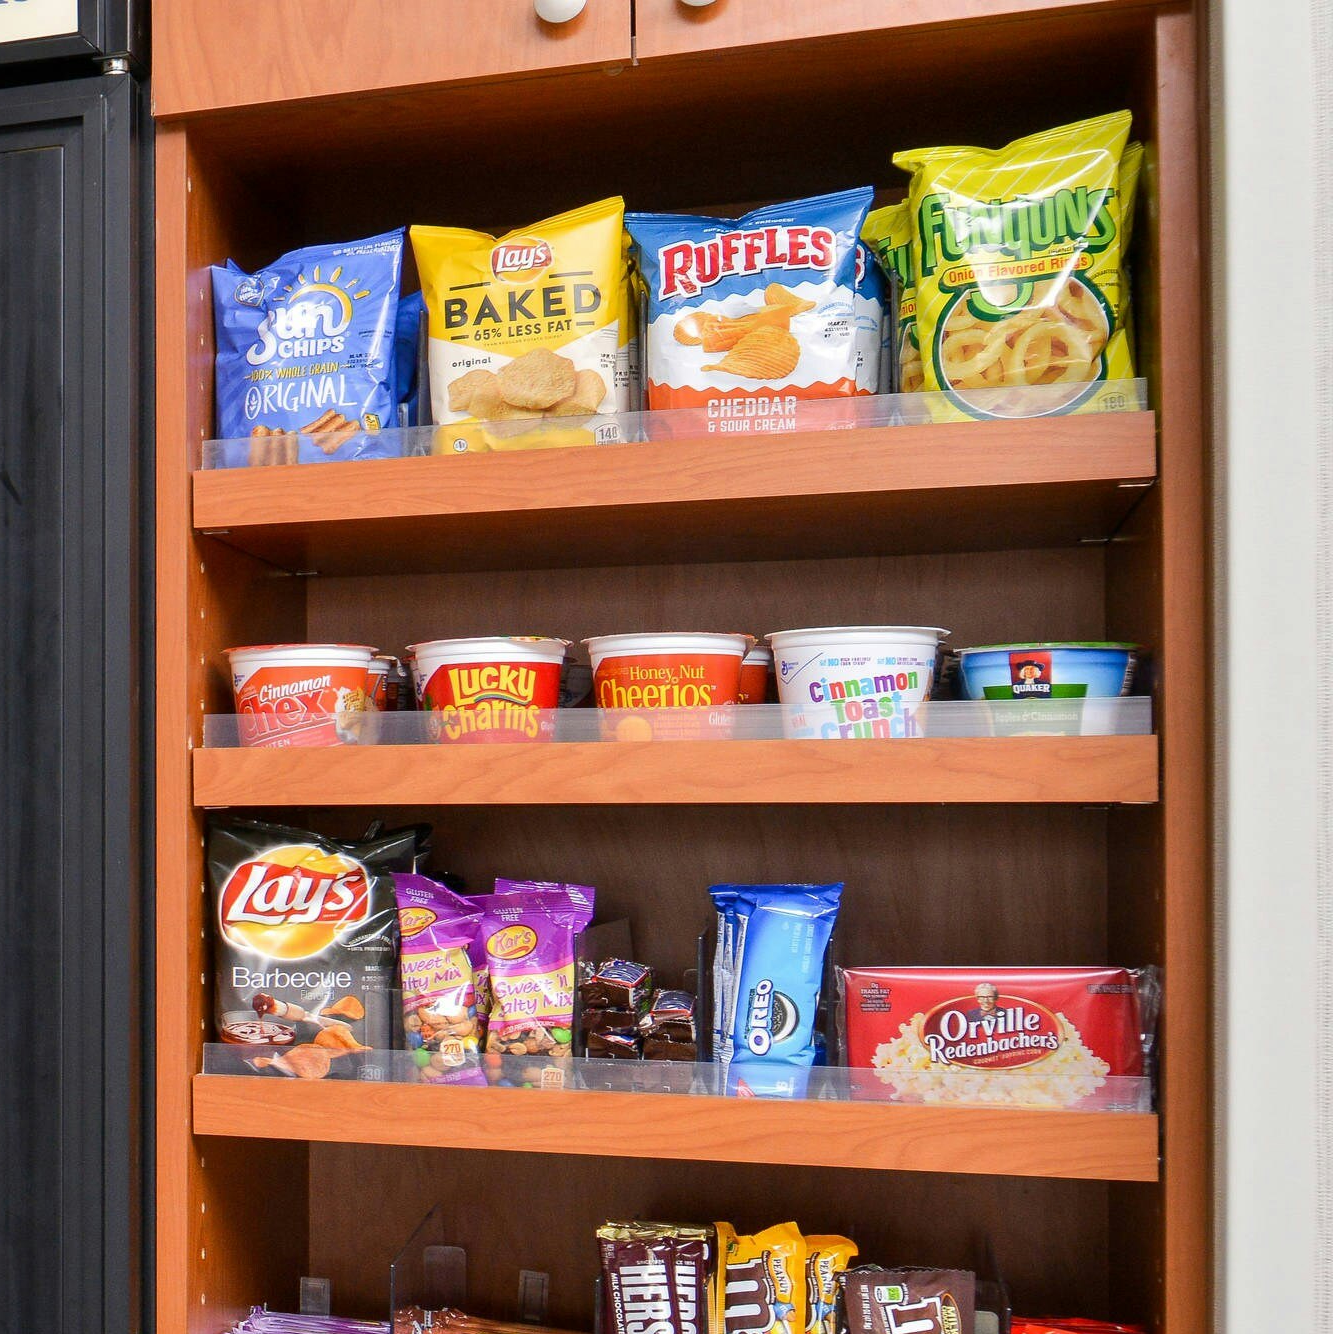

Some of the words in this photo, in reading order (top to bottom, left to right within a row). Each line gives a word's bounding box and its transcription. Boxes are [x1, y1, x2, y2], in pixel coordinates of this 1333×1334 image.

[496, 244, 548, 273] Lay's
[661, 226, 834, 296] RUFFLES
[988, 259, 1045, 278] Flavored
[444, 283, 602, 329] BAKED
[246, 300, 352, 365] Sun
[474, 328, 502, 341] 65%
[508, 323, 541, 337] LESS
[547, 319, 572, 332] FAT
[277, 336, 346, 359] CHIPS
[276, 365, 308, 379] WHOLE
[309, 362, 340, 375] GRAIN
[452, 357, 492, 368] original
[245, 374, 357, 420] ORIGINAL
[707, 396, 797, 418] CHEDDAR
[708, 422, 716, 433] &
[720, 420, 750, 432] SOUR
[754, 419, 796, 432] CREAM
[448, 664, 536, 707] Lucky
[630, 666, 674, 684] Honey
[680, 665, 705, 679] Nut
[809, 671, 918, 703] Cinnamon
[259, 674, 330, 702] Cinnamon
[599, 676, 712, 714] Cheerios
[1013, 683, 1050, 694] QUAKER
[239, 689, 337, 741] Chex
[830, 691, 903, 724] Toast
[442, 703, 540, 740] Charms
[820, 707, 918, 739] Crunch
[226, 865, 361, 926] Lay's
[405, 888, 434, 899] GLUTEN
[410, 895, 429, 905] FREE
[493, 907, 524, 916] GLUTEN
[501, 912, 521, 922] FREE
[494, 930, 532, 951] Kar's
[233, 967, 352, 988] Barbecue
[748, 979, 774, 1056] OREO
[939, 1007, 1040, 1043] Orville
[443, 1043, 461, 1053] 270
[924, 1032, 1059, 1066] Redenbacher's
[543, 1071, 561, 1081] 270
[610, 1272, 619, 1291] MILK
[773, 1258, 790, 1294] PEANUT
